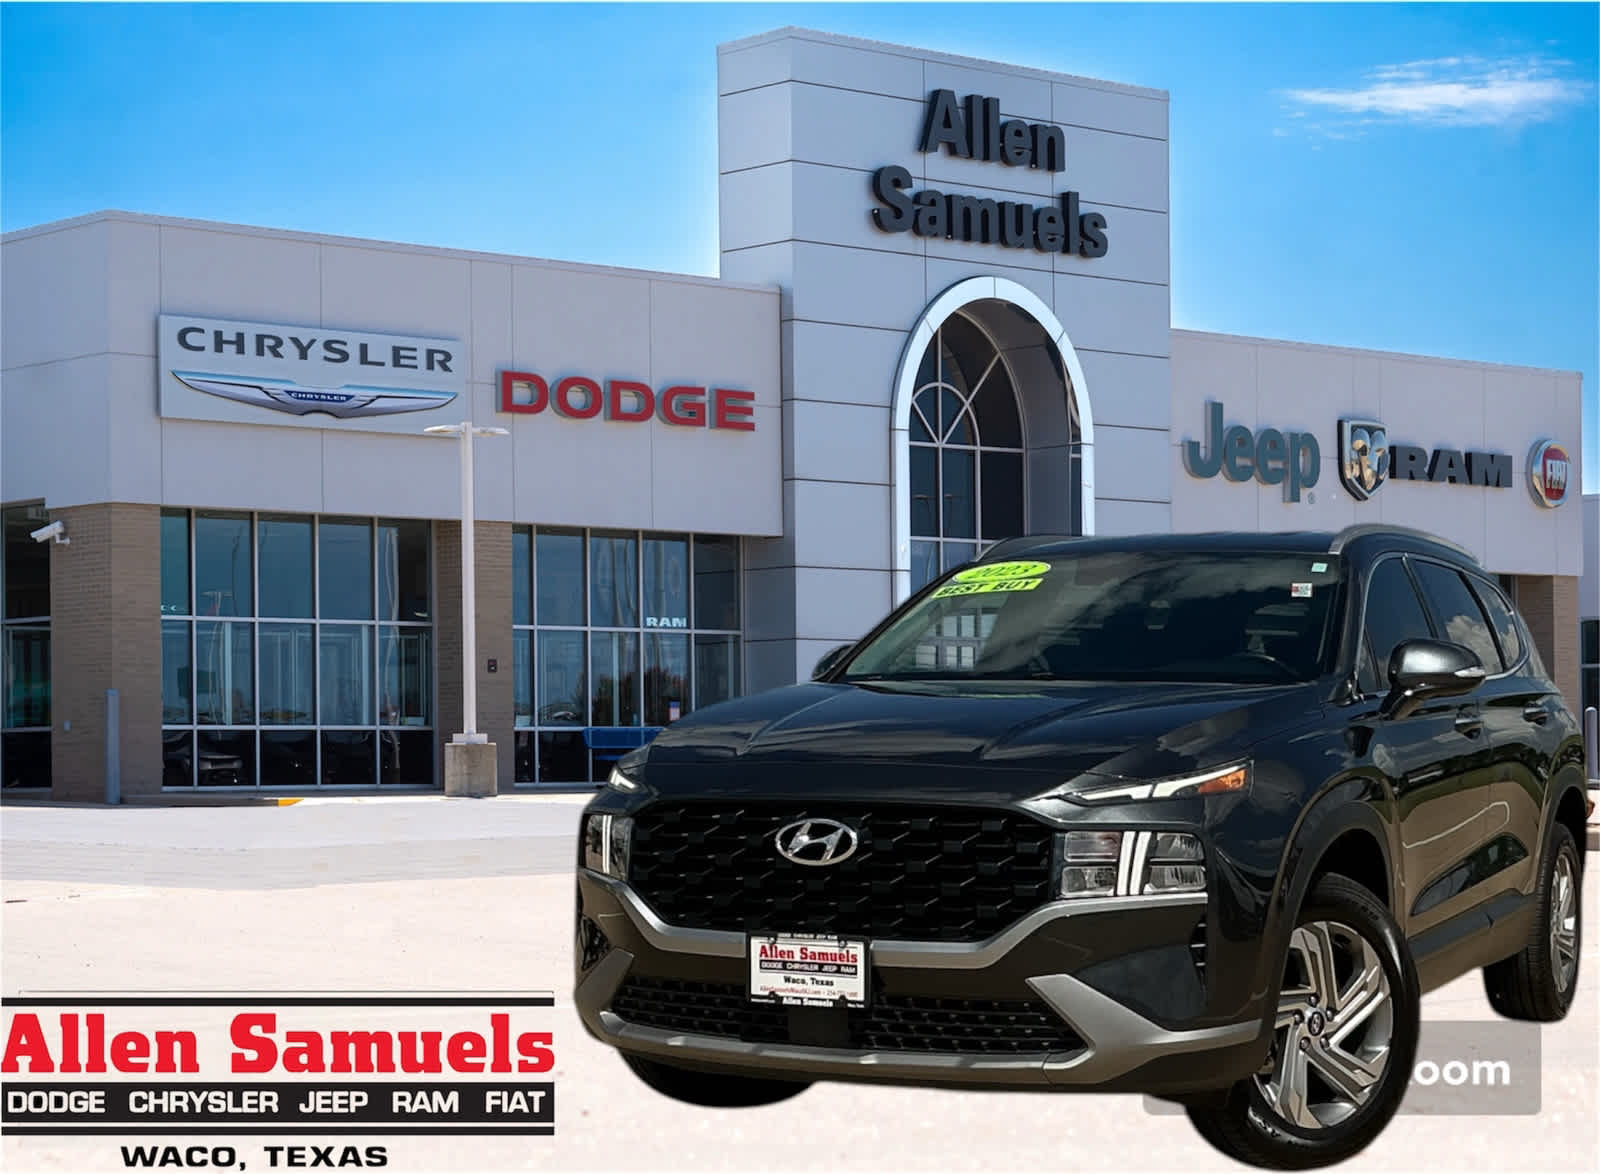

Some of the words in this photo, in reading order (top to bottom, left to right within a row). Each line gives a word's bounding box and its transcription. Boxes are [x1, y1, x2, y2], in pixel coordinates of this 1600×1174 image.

[919, 88, 1066, 172] Allen
[872, 165, 1108, 258] Samuels
[177, 326, 453, 373] CHRYSLER
[291, 392, 346, 401] CHRYSLER
[496, 370, 756, 432] DODGE
[1183, 399, 1321, 503] Jeep
[1389, 444, 1513, 489] RAM
[936, 583, 990, 596] BEST
[992, 580, 1036, 590] BUY
[645, 616, 687, 628] RAM
[760, 944, 795, 960] Allen
[799, 947, 858, 963] Samuels
[786, 962, 820, 972] CHRYSLER
[822, 964, 838, 972] JEEP
[810, 977, 834, 987] Texas
